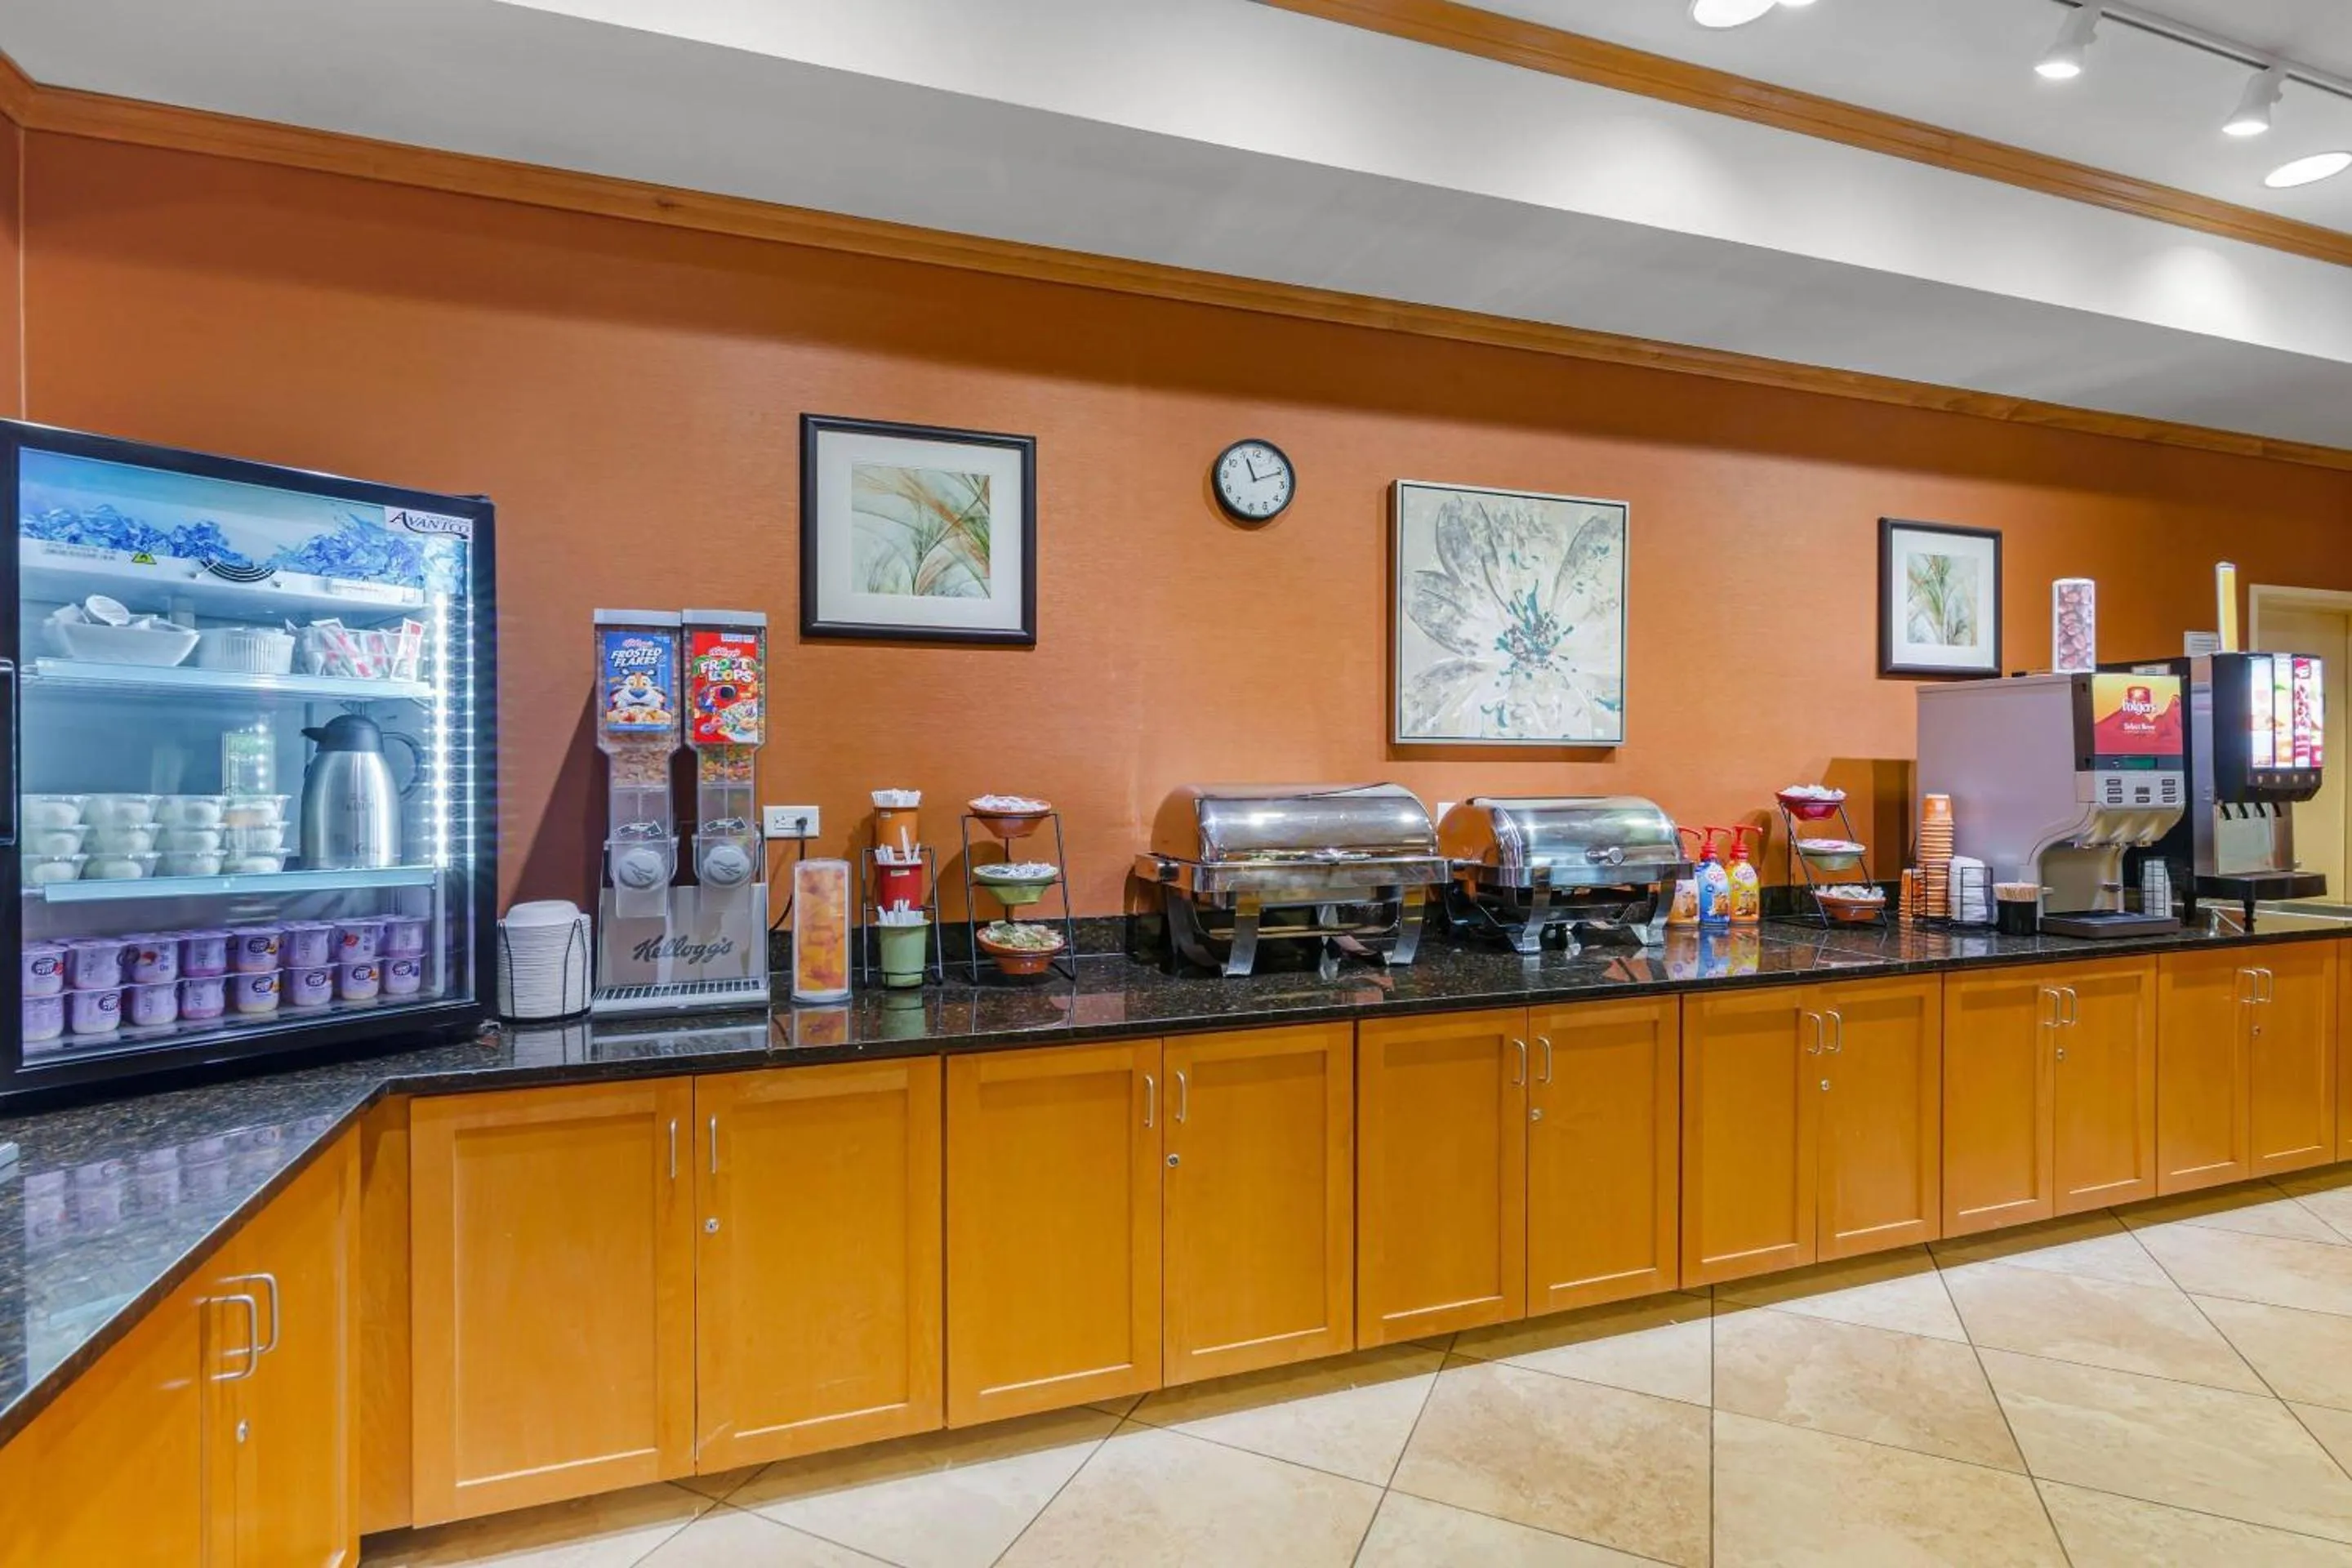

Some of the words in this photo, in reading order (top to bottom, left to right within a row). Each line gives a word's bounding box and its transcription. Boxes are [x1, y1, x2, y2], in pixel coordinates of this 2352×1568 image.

[1253, 450, 1261, 458] 12
[1229, 459, 1238, 468] 10
[1279, 480, 1285, 489] 3
[611, 646, 663, 659] FROSTED
[614, 656, 657, 667] FLAKES
[700, 657, 752, 674] FROOT
[633, 934, 733, 964] Kellogg's
